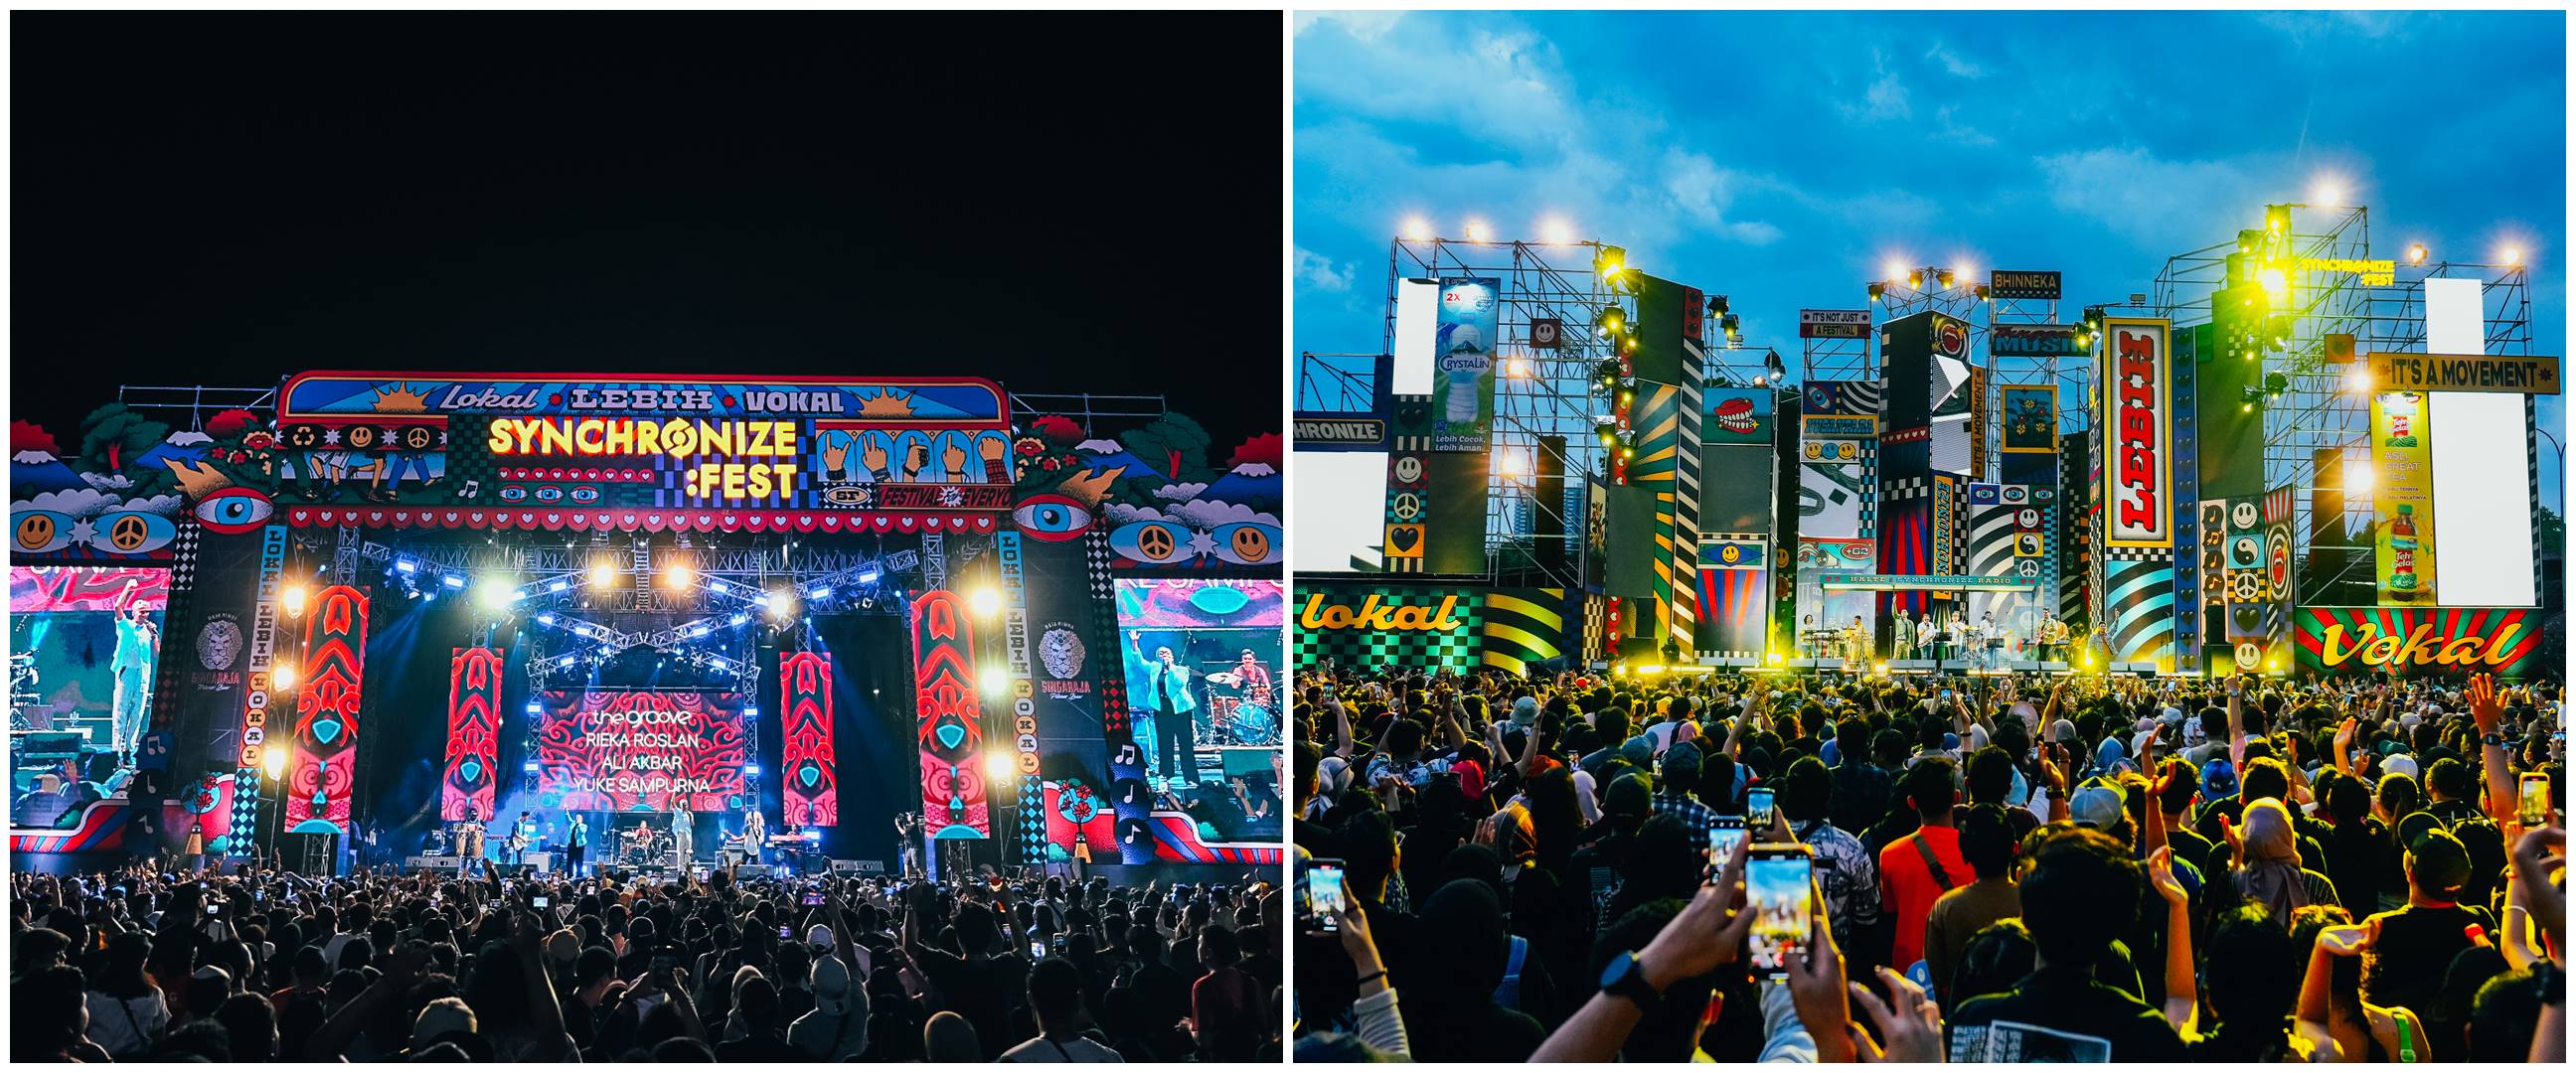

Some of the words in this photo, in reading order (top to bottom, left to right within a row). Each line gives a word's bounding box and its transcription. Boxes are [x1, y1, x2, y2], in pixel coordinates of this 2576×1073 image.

[1995, 273, 2056, 288] BHINNEKA
[1446, 293, 1461, 302] 2X
[1812, 313, 1825, 322] IT'S
[1826, 313, 1841, 322] NOT
[1841, 313, 1859, 322] JUST
[1816, 326, 1822, 335] A
[1823, 326, 1855, 335] FESTIVAL
[2391, 358, 2422, 384] IT'S
[2425, 360, 2439, 384] A
[2442, 360, 2537, 386] MOVEMENT
[439, 384, 539, 409] Lokal
[570, 388, 714, 409] LEBIH
[746, 391, 845, 412] VOKAL
[488, 416, 796, 460] SYNCHRONIZE
[2119, 330, 2156, 534] LEBIH
[2385, 451, 2409, 461] ASLI
[2385, 462, 2419, 471] GREAT
[686, 463, 797, 499] :FEST
[1936, 480, 1951, 578] NCHRONIZE
[261, 531, 282, 596] LOKAL
[1001, 535, 1023, 602] LOKAL
[2396, 551, 2412, 560] Teh
[1301, 593, 1462, 630] lokal
[251, 604, 273, 667] LEBIH
[1008, 611, 1030, 675] LEBIH
[2322, 622, 2522, 667] Vokal
[1042, 681, 1090, 693] SINGARAJA
[245, 677, 268, 759] VOKAL
[593, 709, 625, 724] the
[625, 709, 692, 728] groove
[1017, 685, 1035, 767] VOKAL
[585, 733, 630, 747] RIEKA
[634, 733, 699, 747] ROSLAN
[601, 756, 626, 770] ALI
[629, 756, 683, 770] AKBAR
[573, 778, 616, 793] YUKE
[618, 778, 711, 793] SAMPURNA
